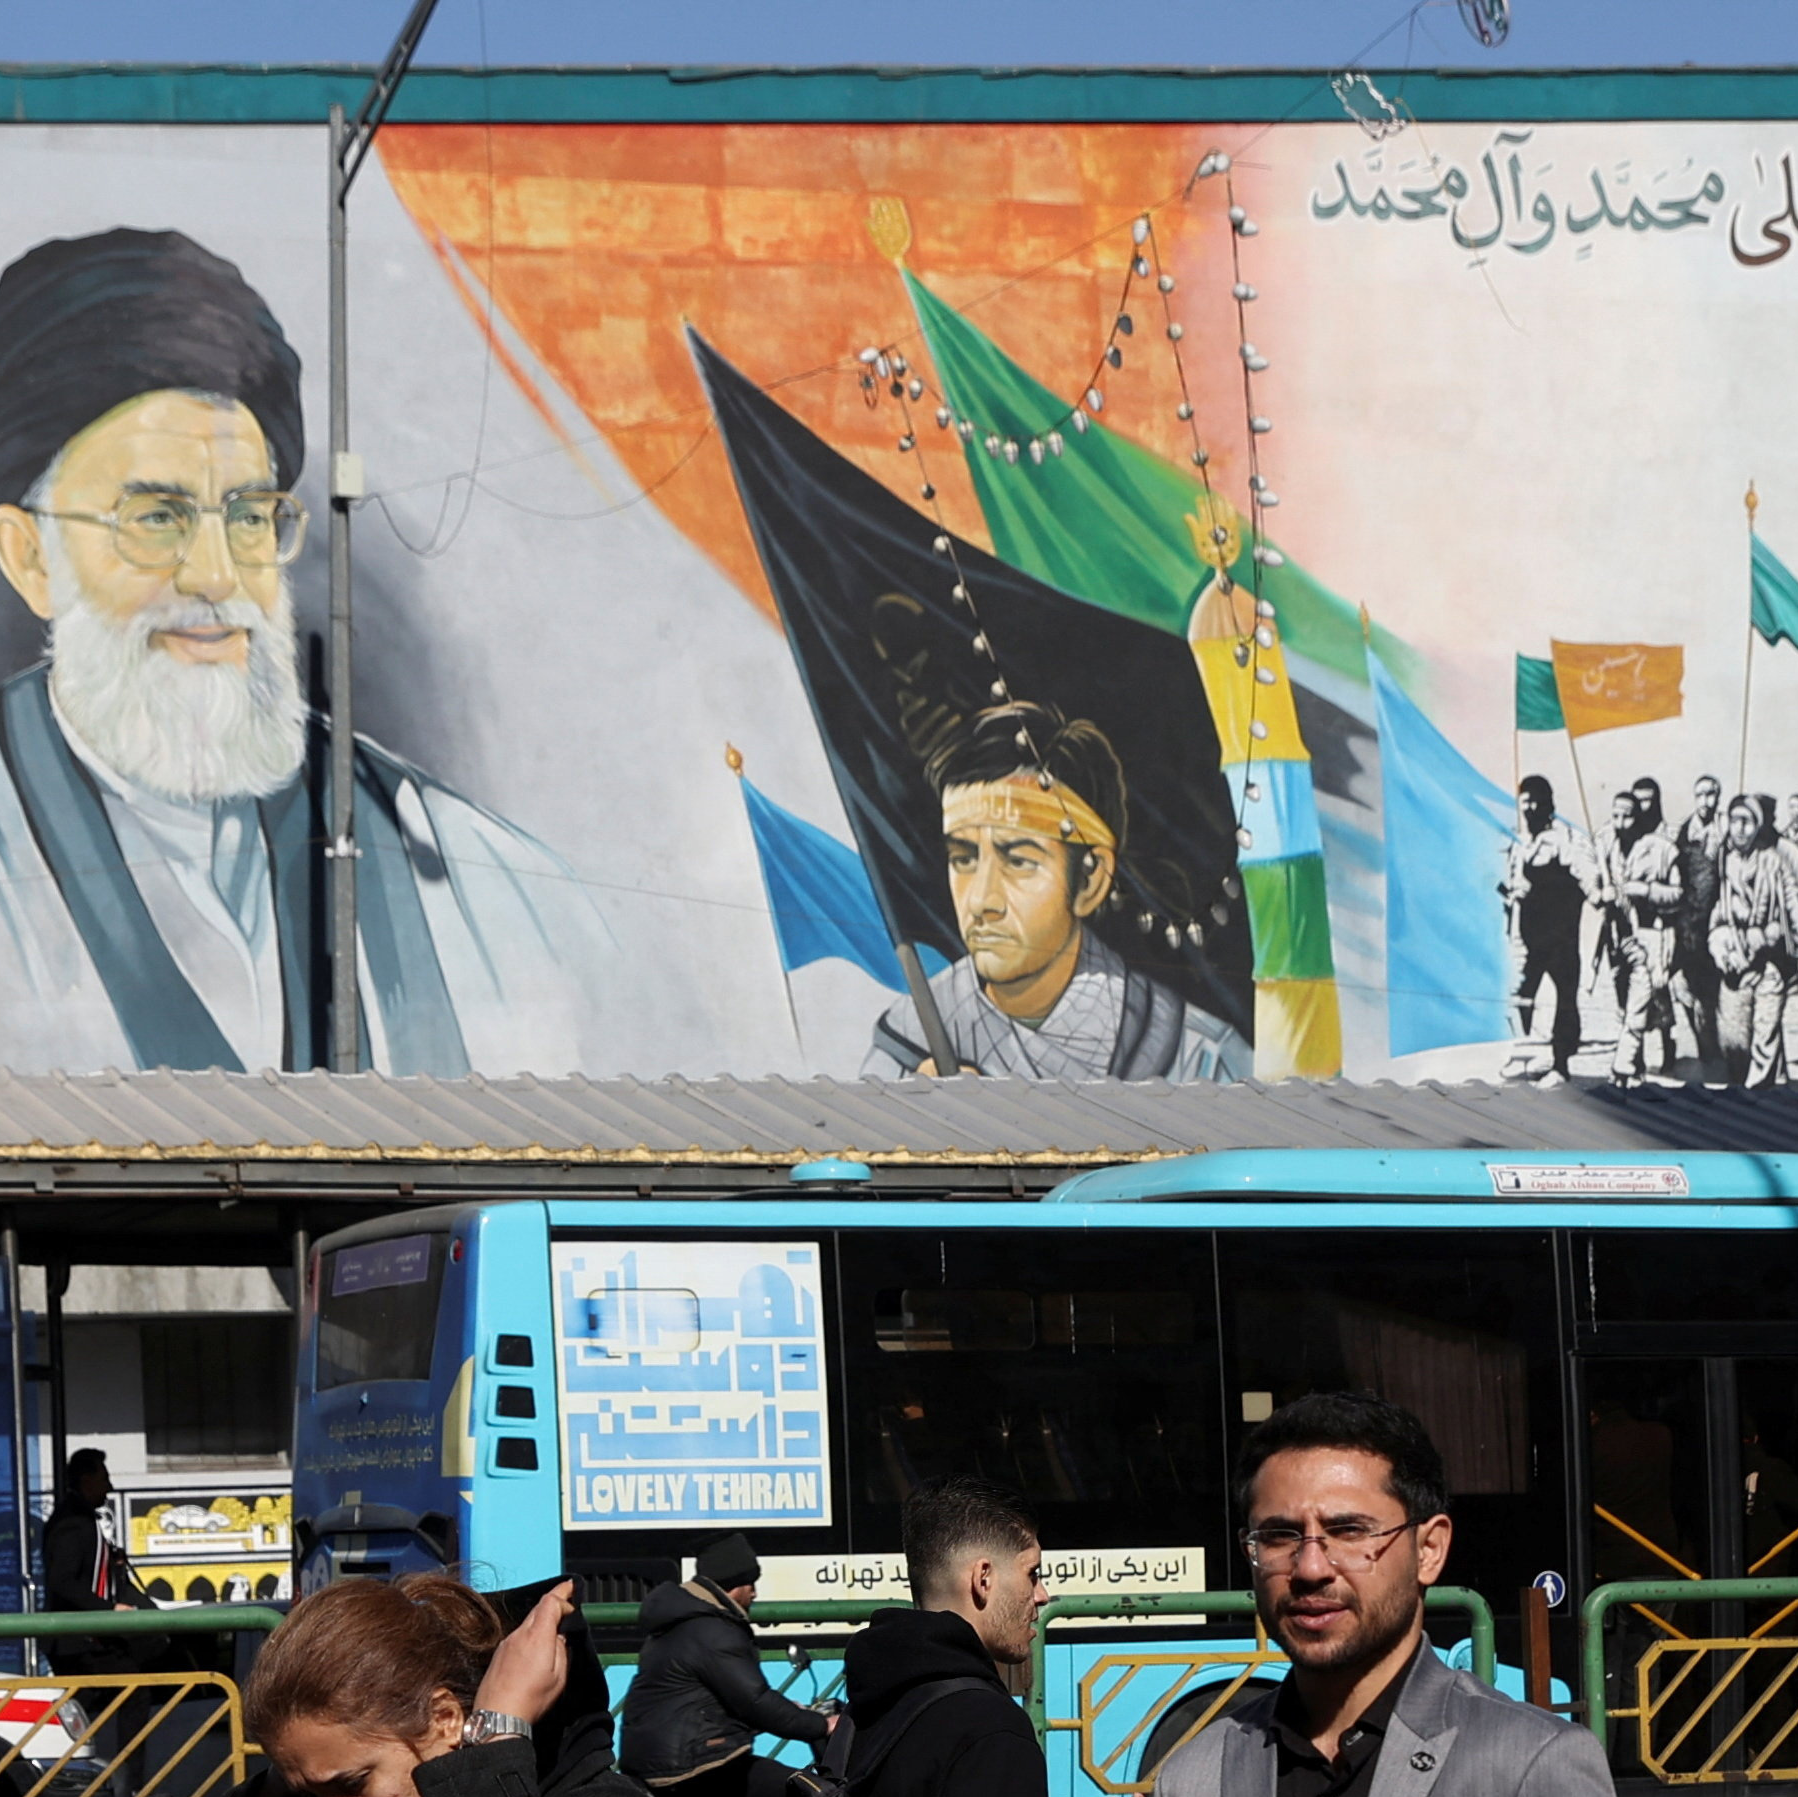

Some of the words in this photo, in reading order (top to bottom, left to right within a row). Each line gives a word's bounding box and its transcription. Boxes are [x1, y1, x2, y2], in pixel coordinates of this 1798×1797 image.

[1530, 1179, 1566, 1191] Oghab
[1569, 1180, 1605, 1190] Afshan
[1607, 1180, 1657, 1193] Company
[575, 1472, 687, 1514] LOVELY
[693, 1471, 817, 1512] TEHRAN
[814, 1561, 886, 1588] تهرانه
[1107, 1556, 1149, 1584] یکی
[1152, 1554, 1189, 1583] این
